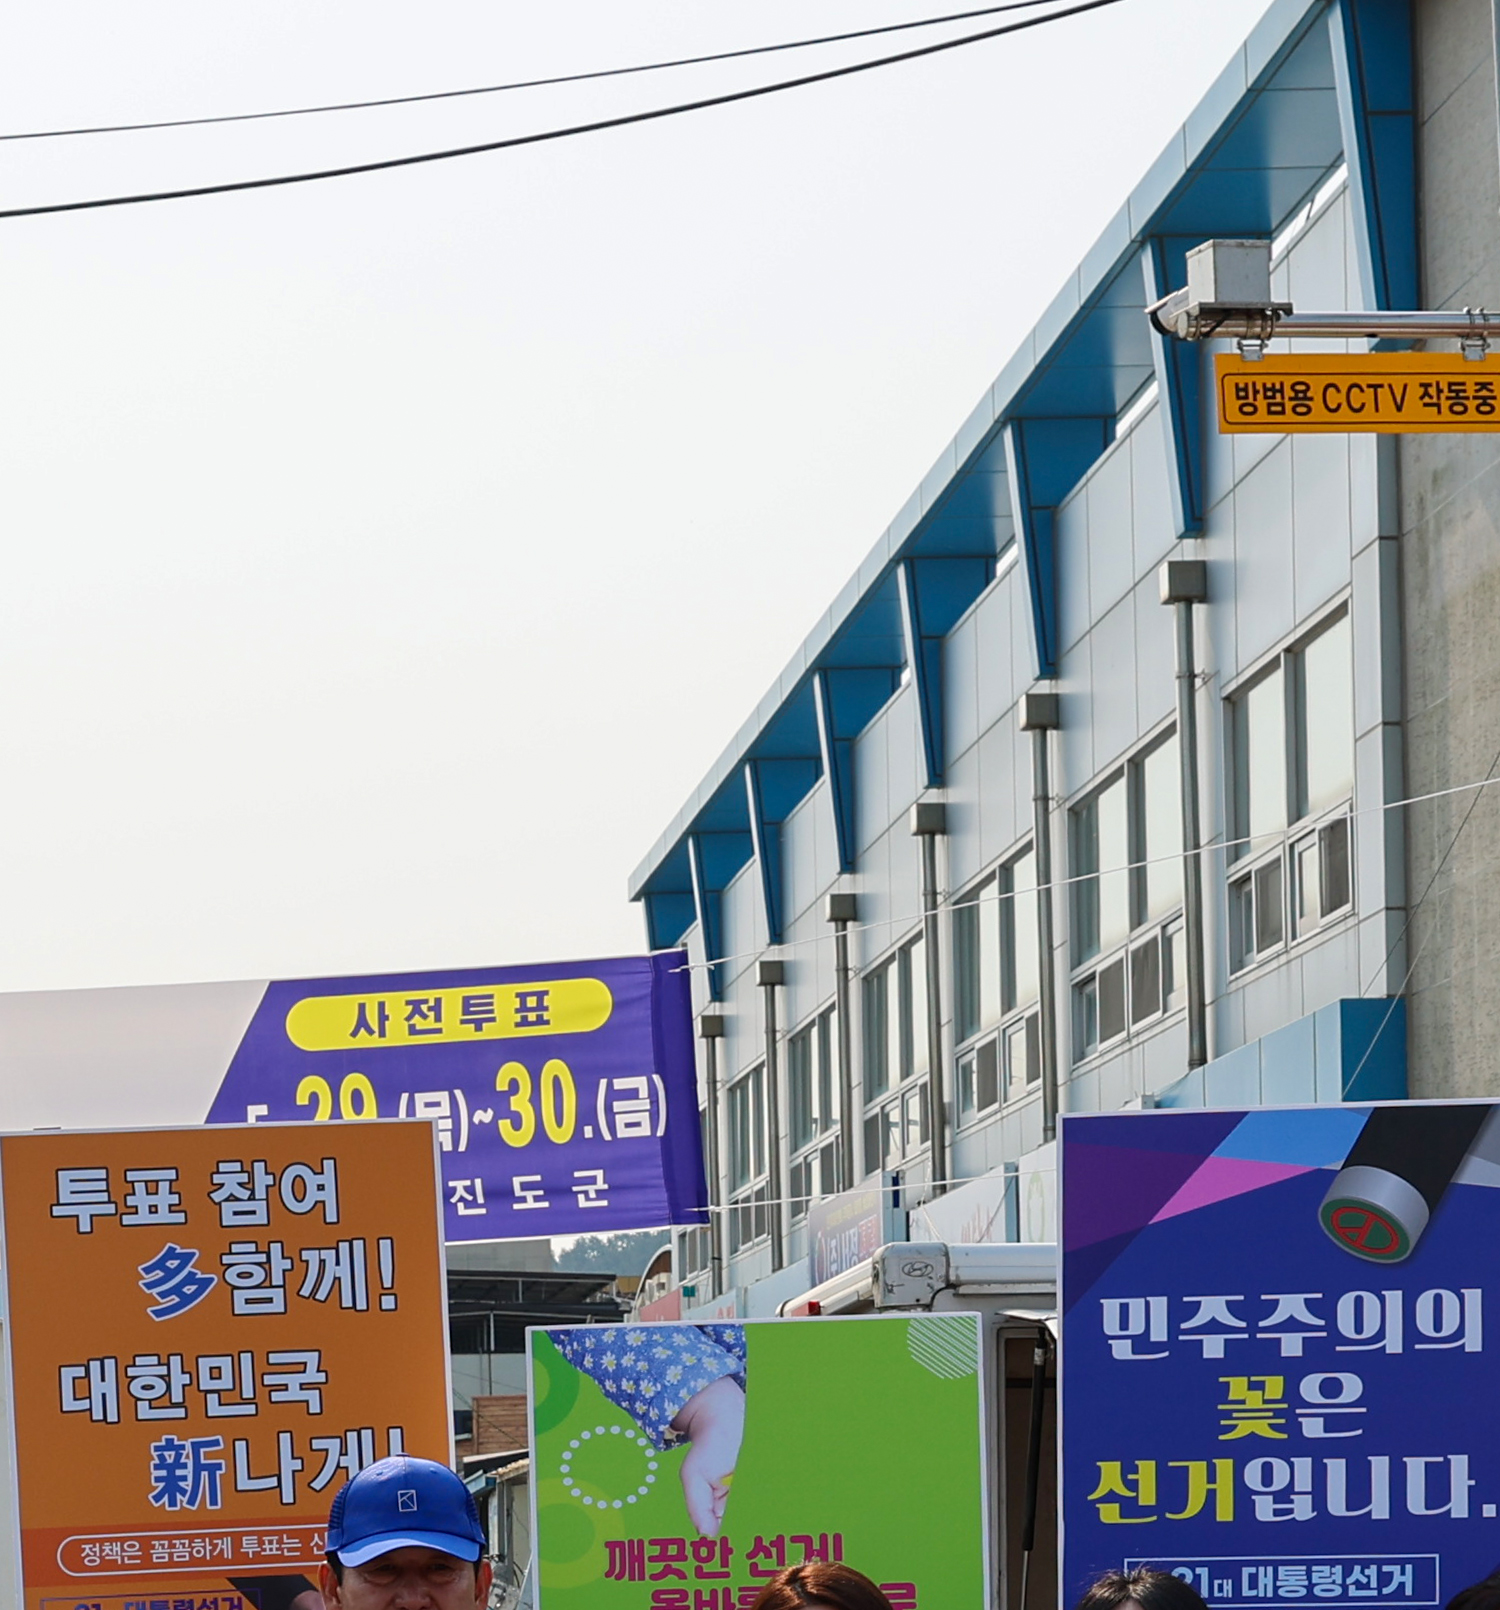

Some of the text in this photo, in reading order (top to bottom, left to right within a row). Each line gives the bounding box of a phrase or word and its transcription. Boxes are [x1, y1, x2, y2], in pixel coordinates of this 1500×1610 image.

[1234, 380, 1498, 416] 방범용 CCTV 작동중
[349, 988, 552, 1041] 사전투표
[50, 1165, 187, 1235] 투표
[208, 1157, 340, 1232] 참여
[1100, 1286, 1483, 1361] 민주주의의
[58, 1348, 329, 1424] 대한민국
[1217, 1371, 1366, 1441] 꽃은
[1086, 1453, 1498, 1525] 선거입니다.
[79, 1538, 142, 1566] 정책은
[148, 1534, 233, 1563] 꼼꼼하게
[239, 1531, 302, 1560] 투표는
[603, 1536, 733, 1583] 깨끗한
[1241, 1564, 1414, 1599] 대통령선거
